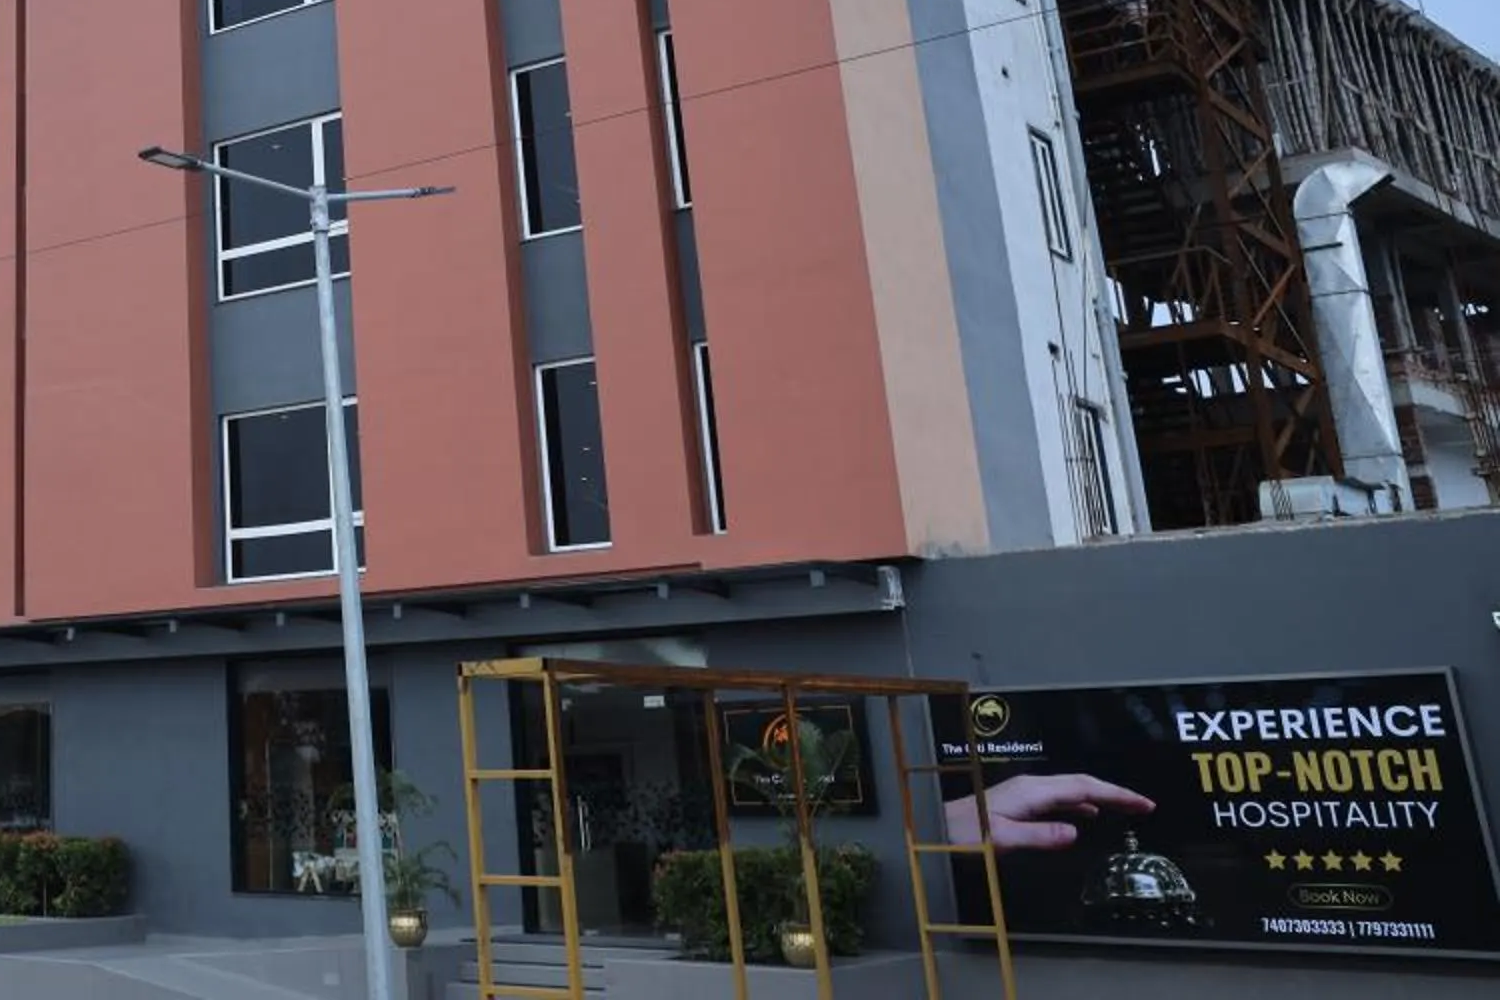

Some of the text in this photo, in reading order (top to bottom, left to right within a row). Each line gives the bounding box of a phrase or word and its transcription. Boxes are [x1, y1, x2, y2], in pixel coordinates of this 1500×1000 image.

[1176, 704, 1445, 742] EXPERIENCE
[1191, 749, 1443, 793] TOP-NOTCH
[1213, 801, 1439, 828] HOSPITALITY
